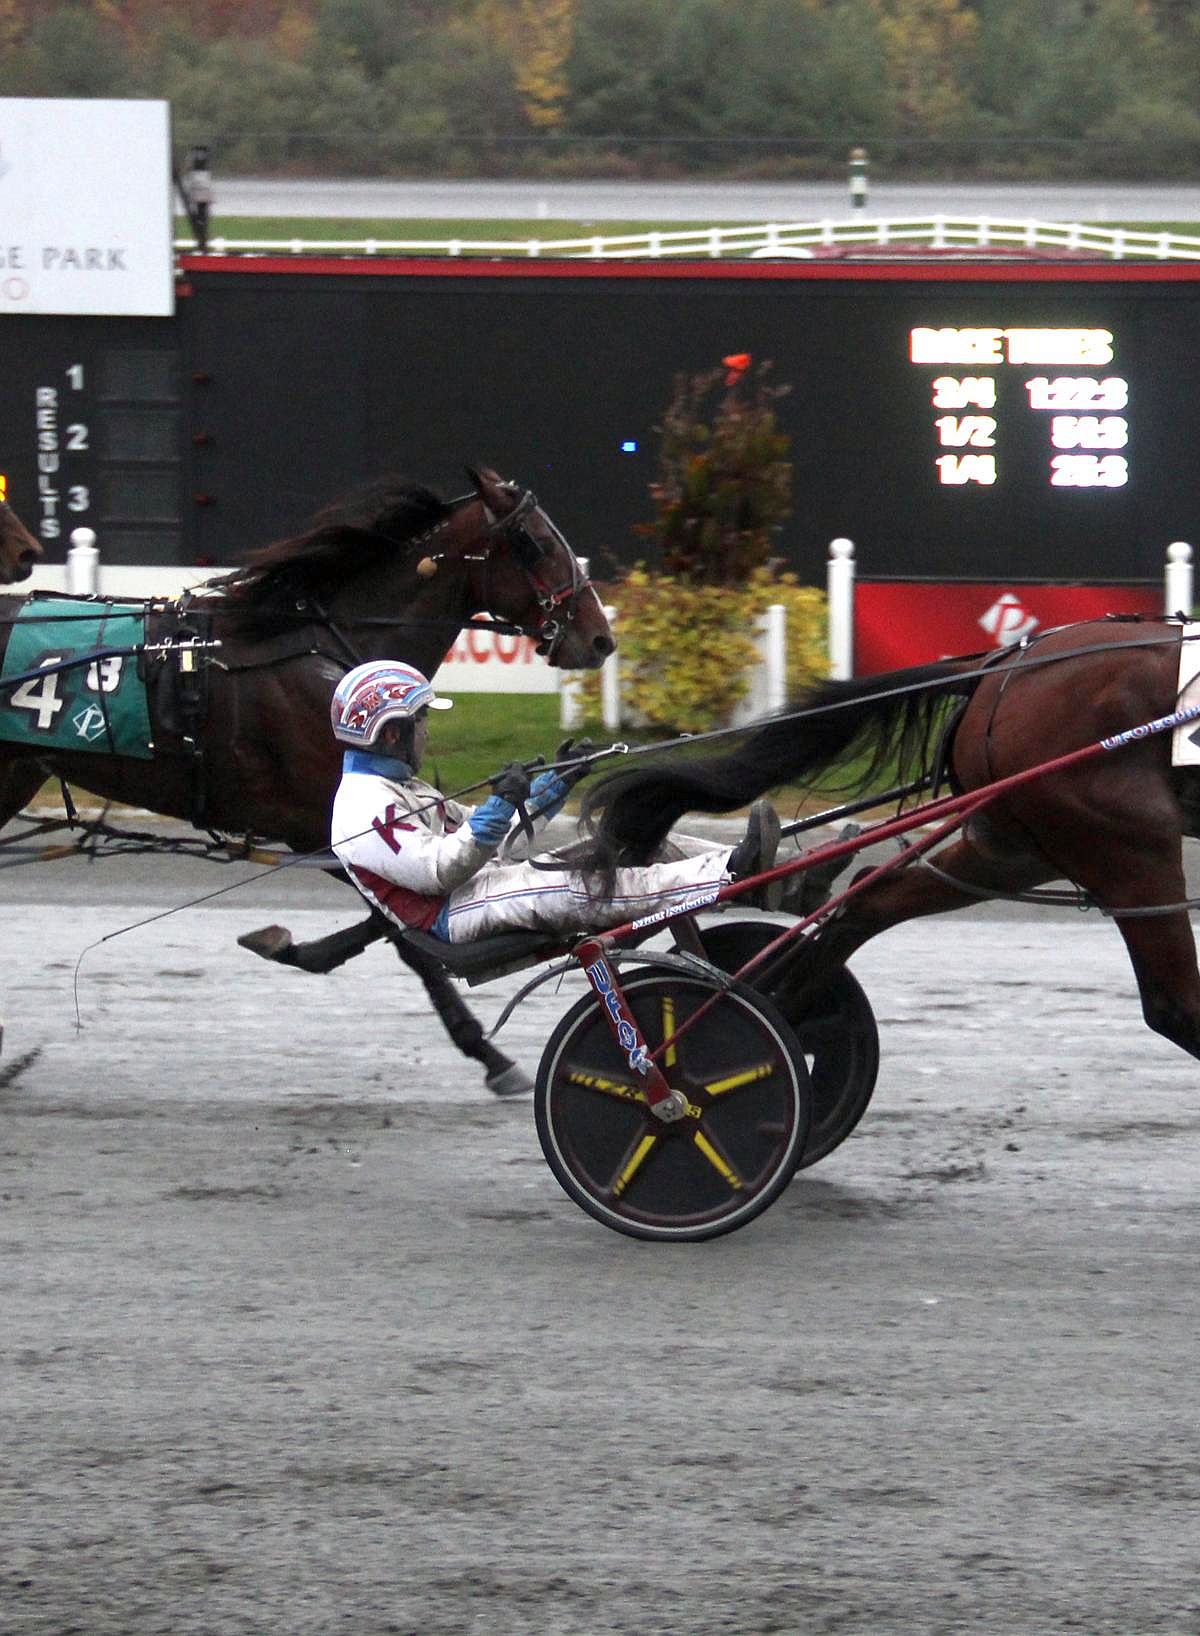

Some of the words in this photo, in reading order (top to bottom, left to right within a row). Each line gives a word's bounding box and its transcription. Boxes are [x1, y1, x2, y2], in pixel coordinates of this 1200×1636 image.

[0, 247, 25, 269] E
[42, 248, 126, 271] PARK
[65, 364, 84, 391] 1
[932, 376, 997, 409] 3/4
[66, 424, 89, 450] 2
[934, 415, 997, 447] 1/2
[36, 386, 61, 538] RESULTS
[935, 454, 997, 486] 1/4
[67, 485, 90, 512] 3
[10, 656, 63, 729] 4
[371, 803, 418, 856] K
